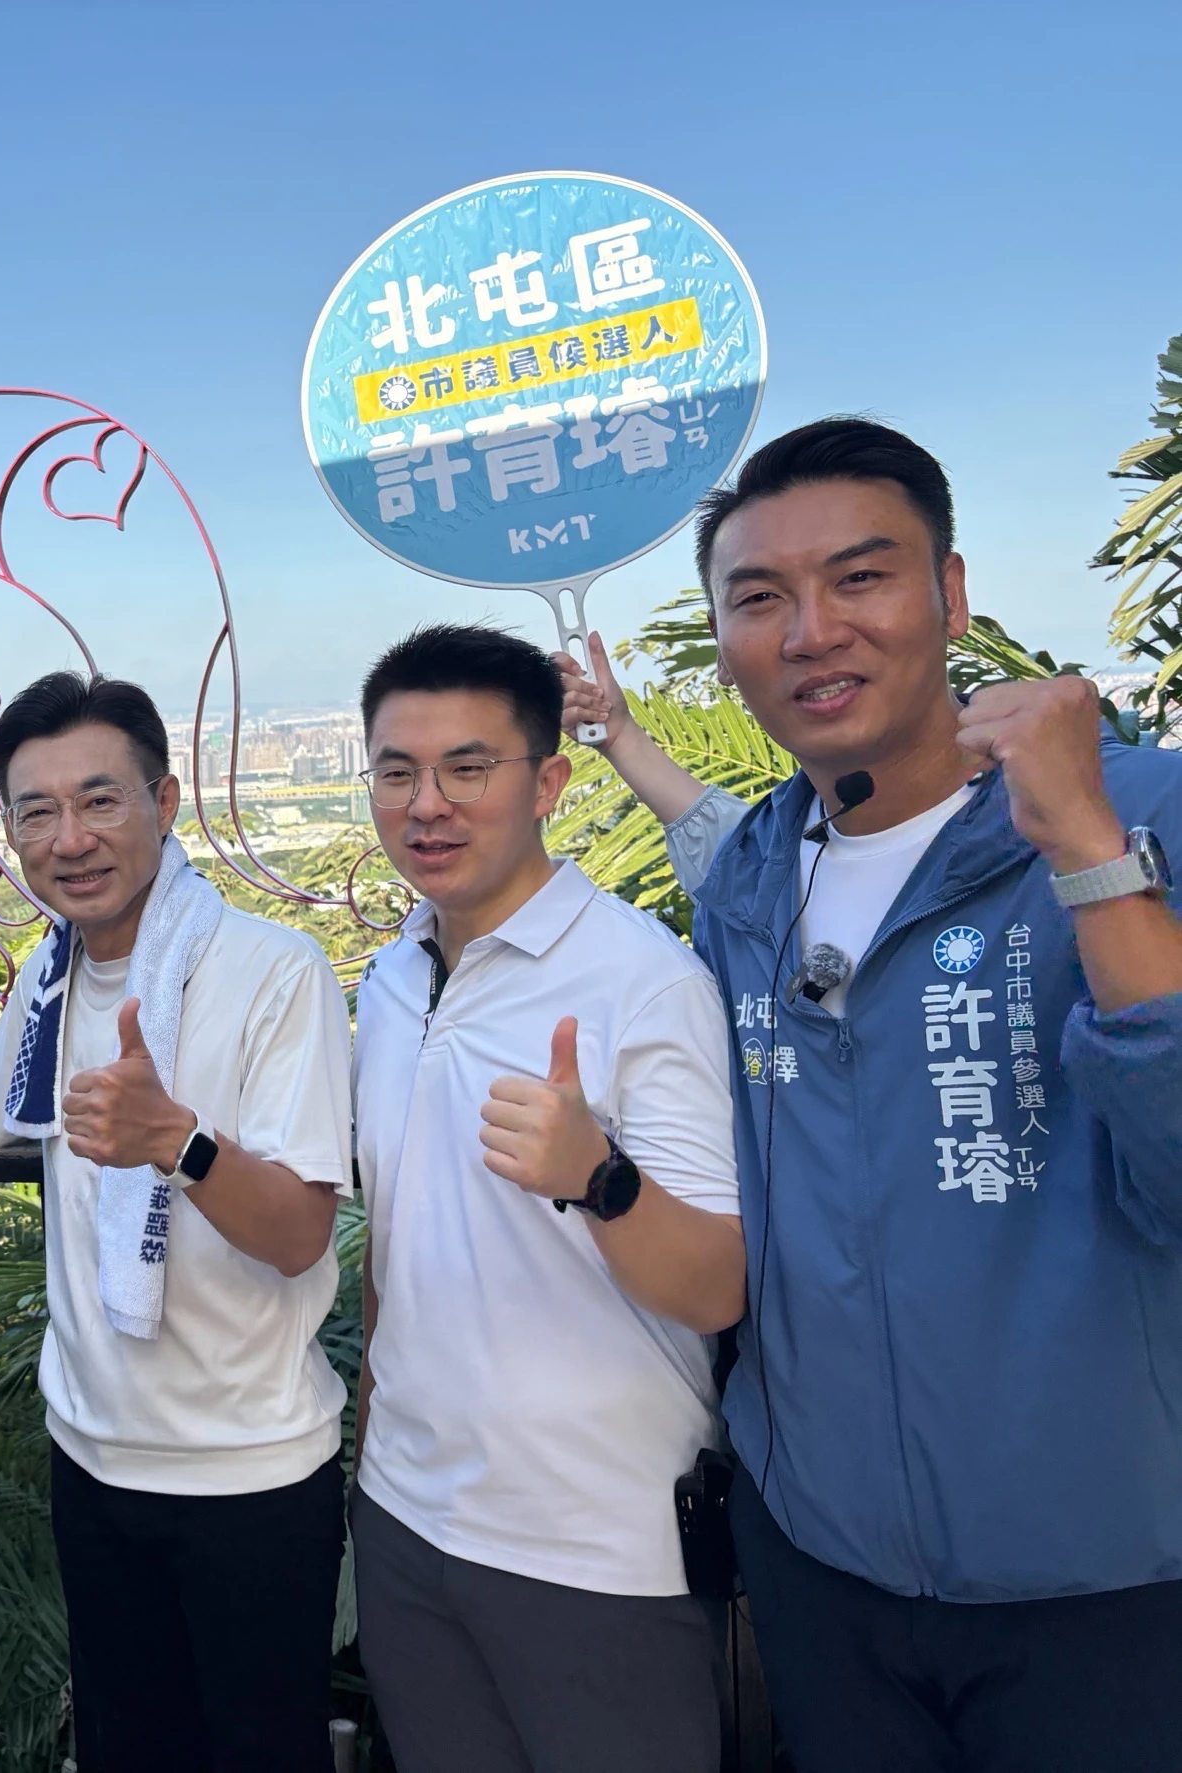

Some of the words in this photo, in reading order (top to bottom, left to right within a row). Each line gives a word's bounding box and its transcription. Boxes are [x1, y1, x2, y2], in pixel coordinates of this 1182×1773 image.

[368, 217, 665, 354] 北屯區
[418, 315, 677, 400] 市議員候選人
[369, 376, 676, 524] 許育璿
[507, 514, 597, 554] KMT
[736, 992, 778, 1029] 北屯
[1005, 923, 1050, 1137] 台中市議員參選人
[921, 981, 1014, 1203] 許育璿
